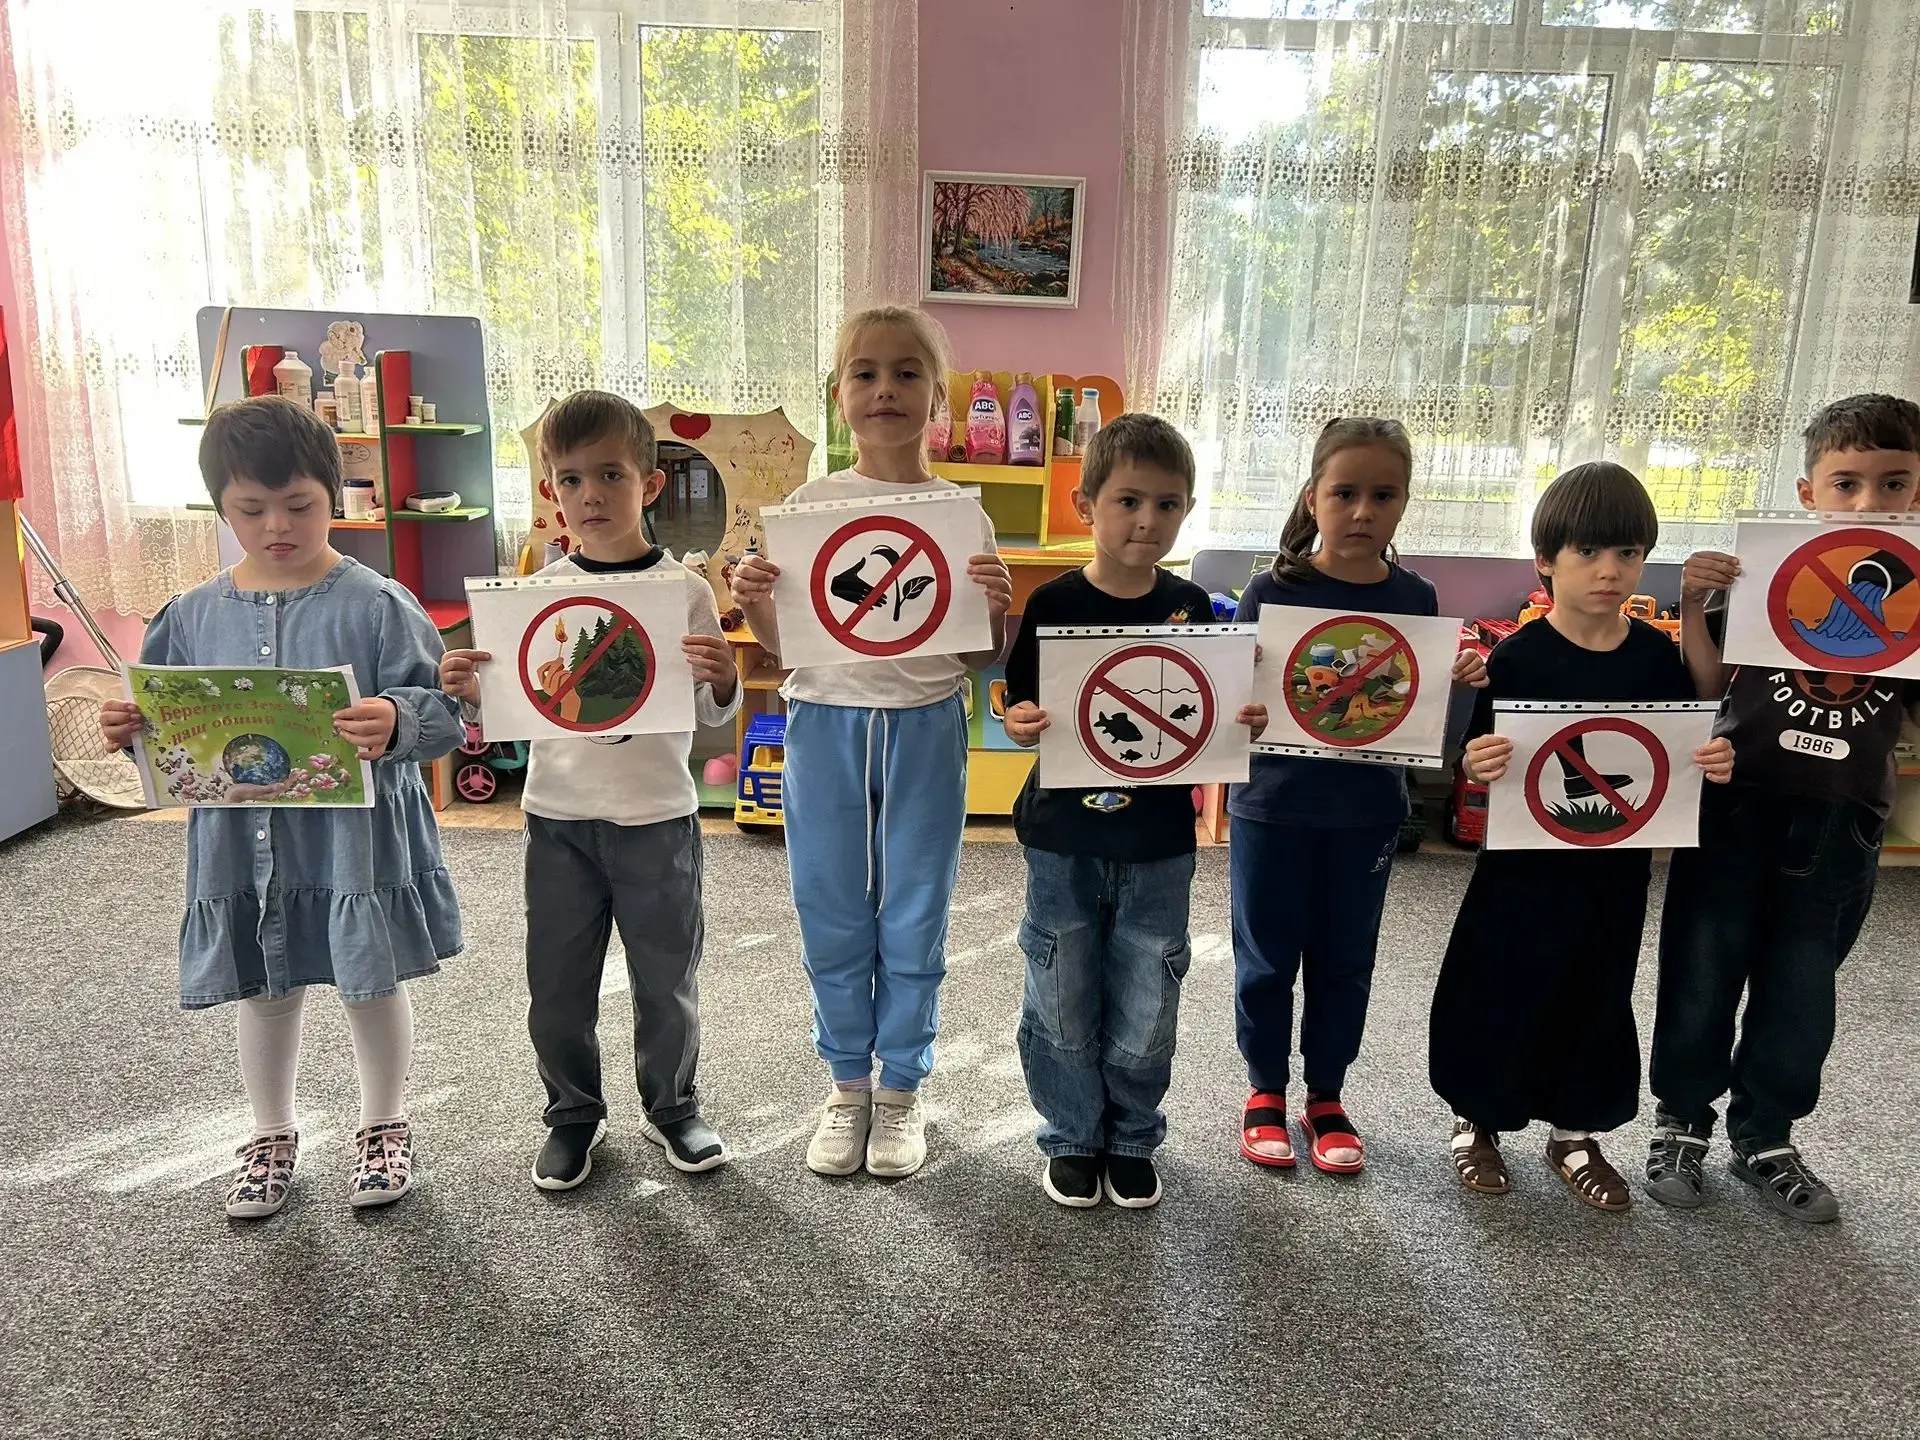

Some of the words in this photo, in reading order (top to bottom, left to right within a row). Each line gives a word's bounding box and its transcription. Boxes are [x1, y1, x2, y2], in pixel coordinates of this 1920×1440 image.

[974, 401, 995, 411] ABC
[1768, 671, 1894, 729] FOOTBALL
[160, 702, 243, 722] Берегите
[172, 723, 207, 746] наш
[1793, 735, 1834, 754] 1986
